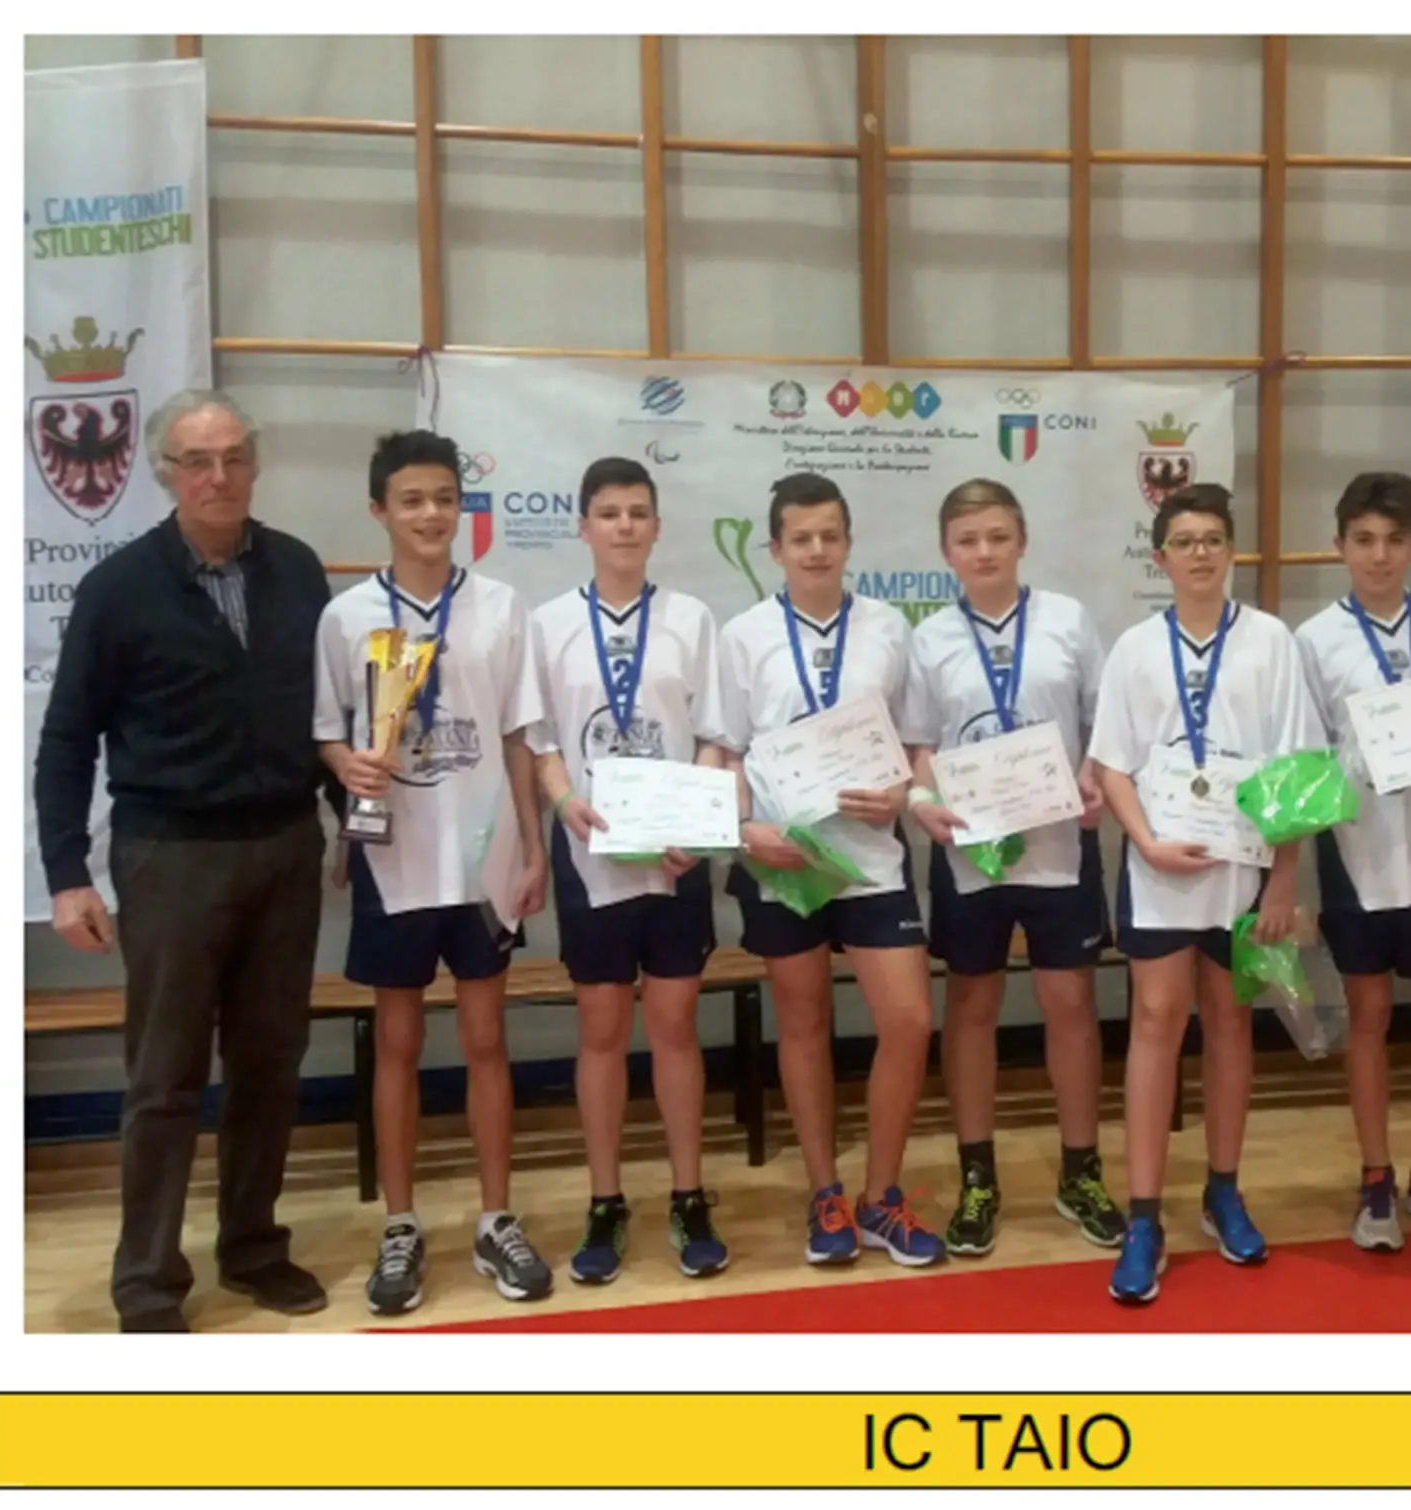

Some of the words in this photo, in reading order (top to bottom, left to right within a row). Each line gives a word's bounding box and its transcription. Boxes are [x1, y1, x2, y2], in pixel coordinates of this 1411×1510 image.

[44, 184, 183, 225] CAMPIONATI
[32, 213, 192, 260] STUDENTESCHI
[1043, 412, 1098, 431] CONI
[503, 491, 573, 515] CON
